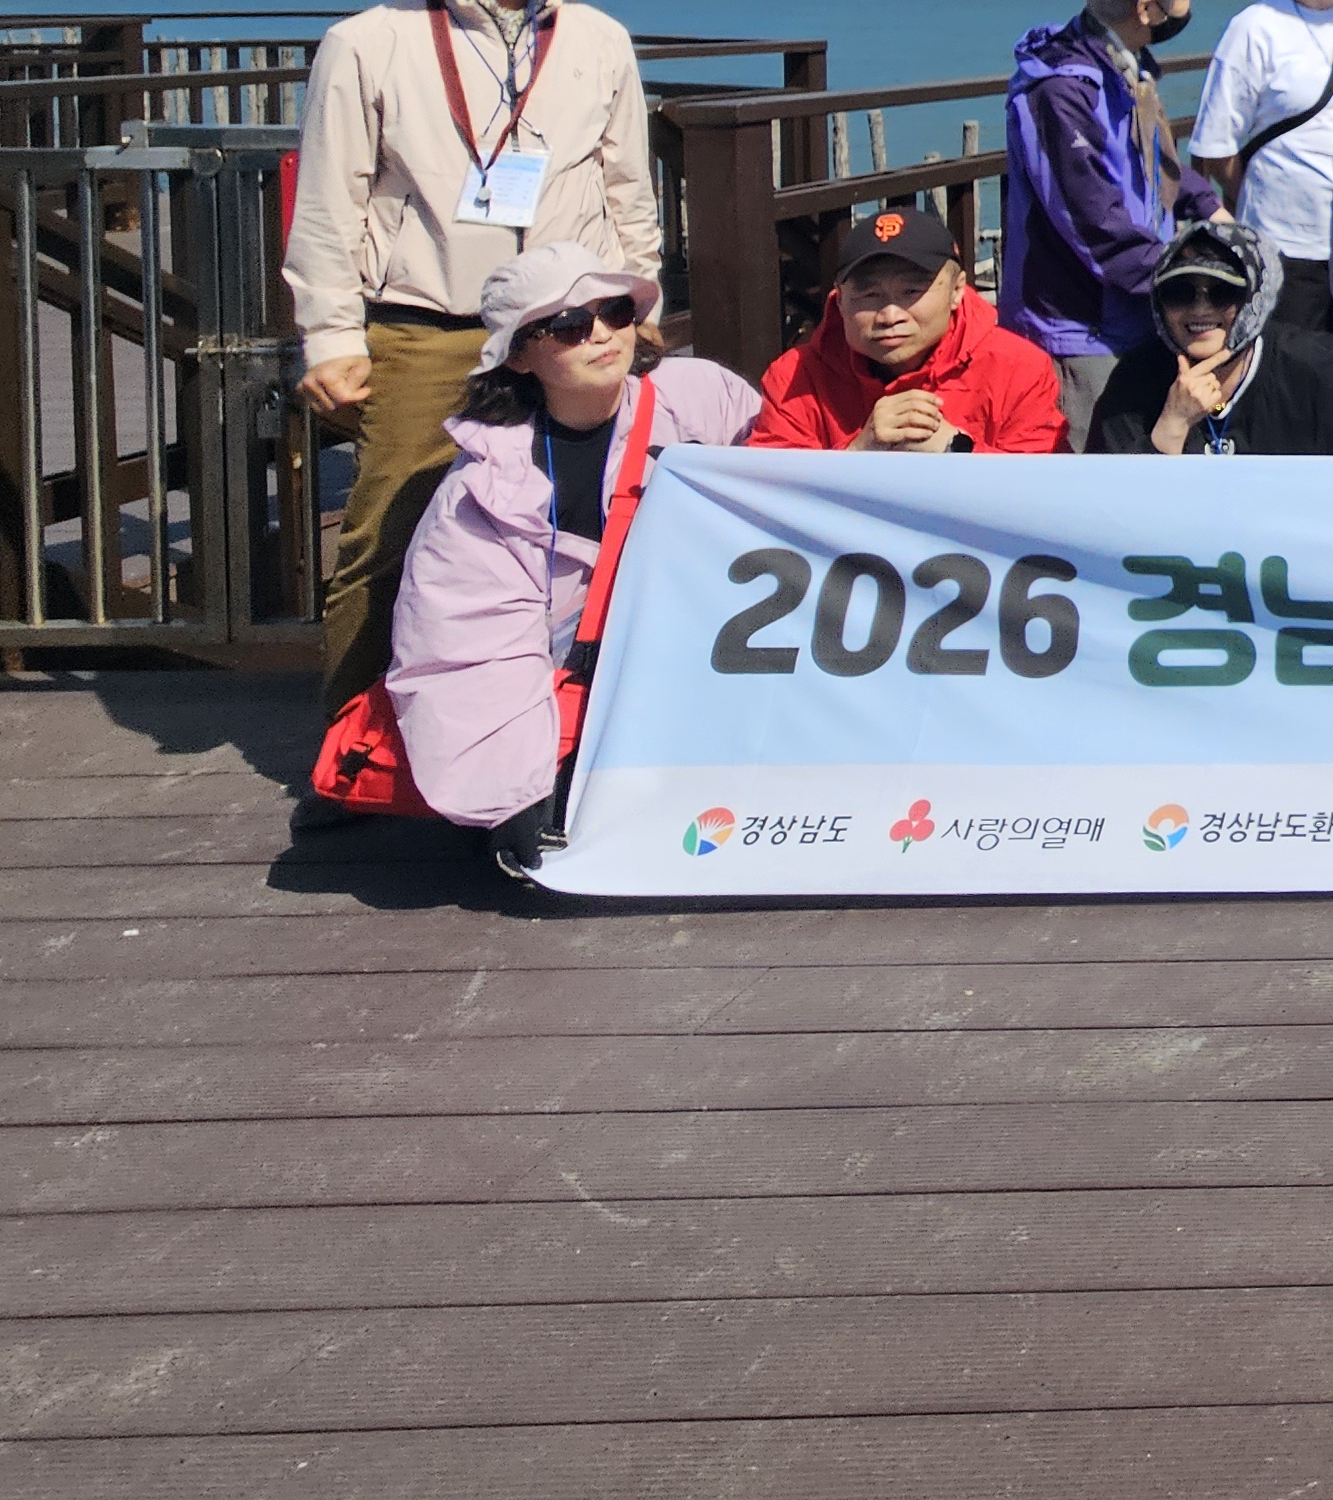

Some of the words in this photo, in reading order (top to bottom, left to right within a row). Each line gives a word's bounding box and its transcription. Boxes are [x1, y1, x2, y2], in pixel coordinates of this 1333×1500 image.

[711, 548, 1079, 679] 2026
[741, 814, 853, 846] 경상남도
[941, 816, 1106, 851] 사랑의열매
